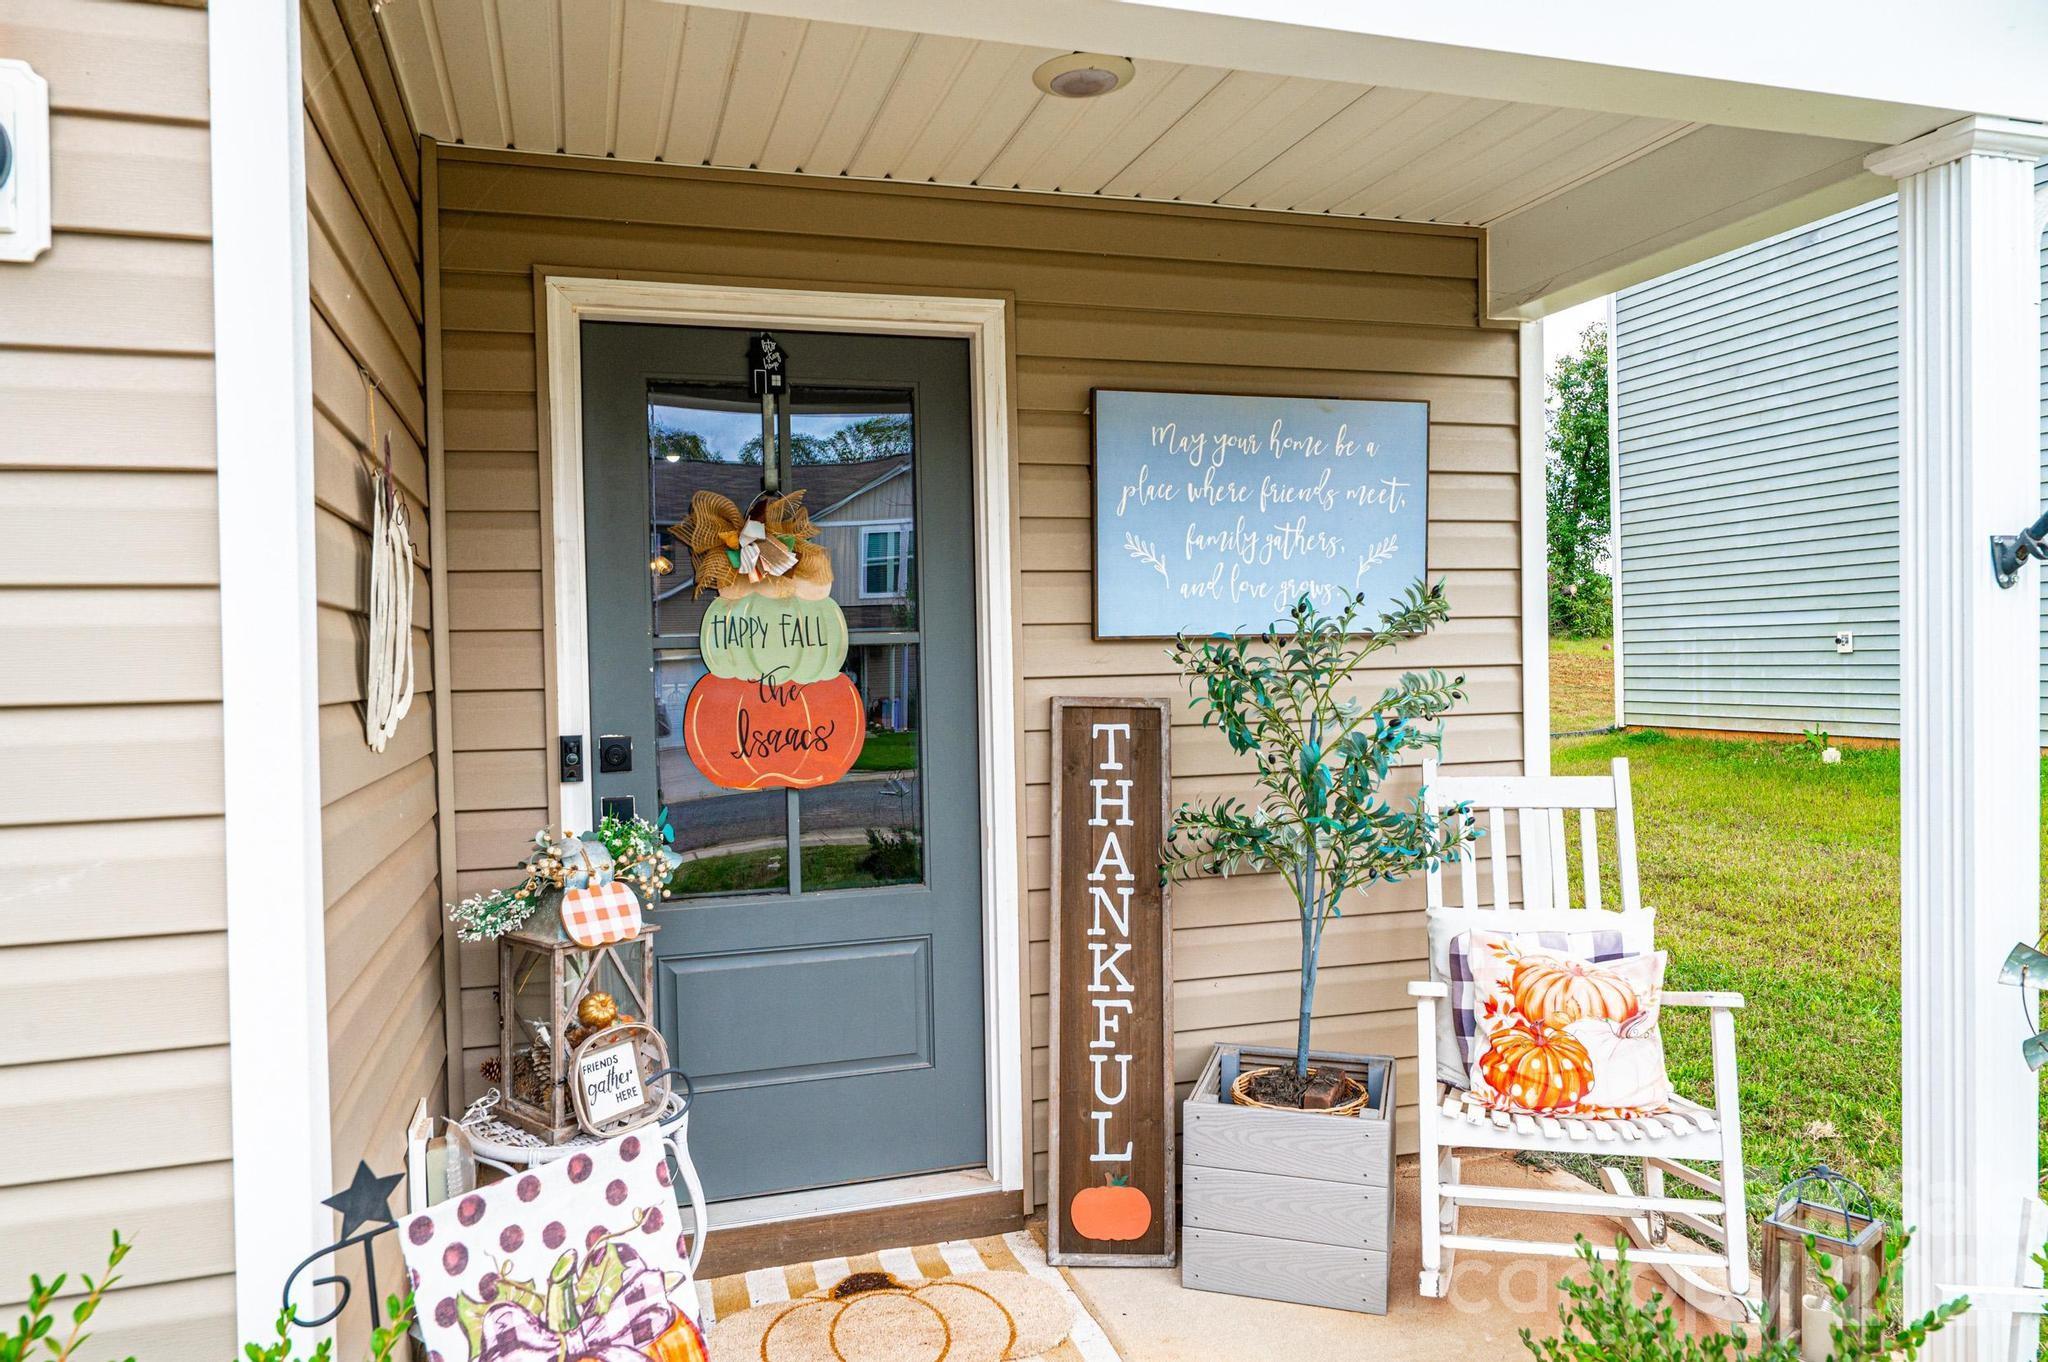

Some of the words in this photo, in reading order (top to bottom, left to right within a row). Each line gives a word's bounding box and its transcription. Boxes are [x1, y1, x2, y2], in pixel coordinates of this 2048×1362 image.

[1151, 422, 1207, 467] May
[1213, 426, 1262, 467] your
[1270, 418, 1328, 459] home
[1335, 423, 1361, 457] be
[1366, 441, 1382, 457] a
[1116, 464, 1181, 516] place
[1187, 466, 1254, 506] where
[1259, 468, 1338, 513] friends
[1346, 476, 1411, 514] meet,
[1185, 515, 1261, 565] family
[1260, 516, 1346, 565] gathers,
[1179, 562, 1225, 600] and
[1231, 563, 1274, 604] love
[1273, 574, 1342, 613] grows.
[711, 614, 768, 650] HAPPY
[779, 613, 828, 649] FALL
[747, 665, 816, 707] the
[730, 708, 835, 760] Isaacs
[1087, 723, 1135, 1163] THANKFUL
[582, 1054, 619, 1075] FRIENDS
[588, 1066, 633, 1106] gather
[616, 1086, 639, 1103] HERE
